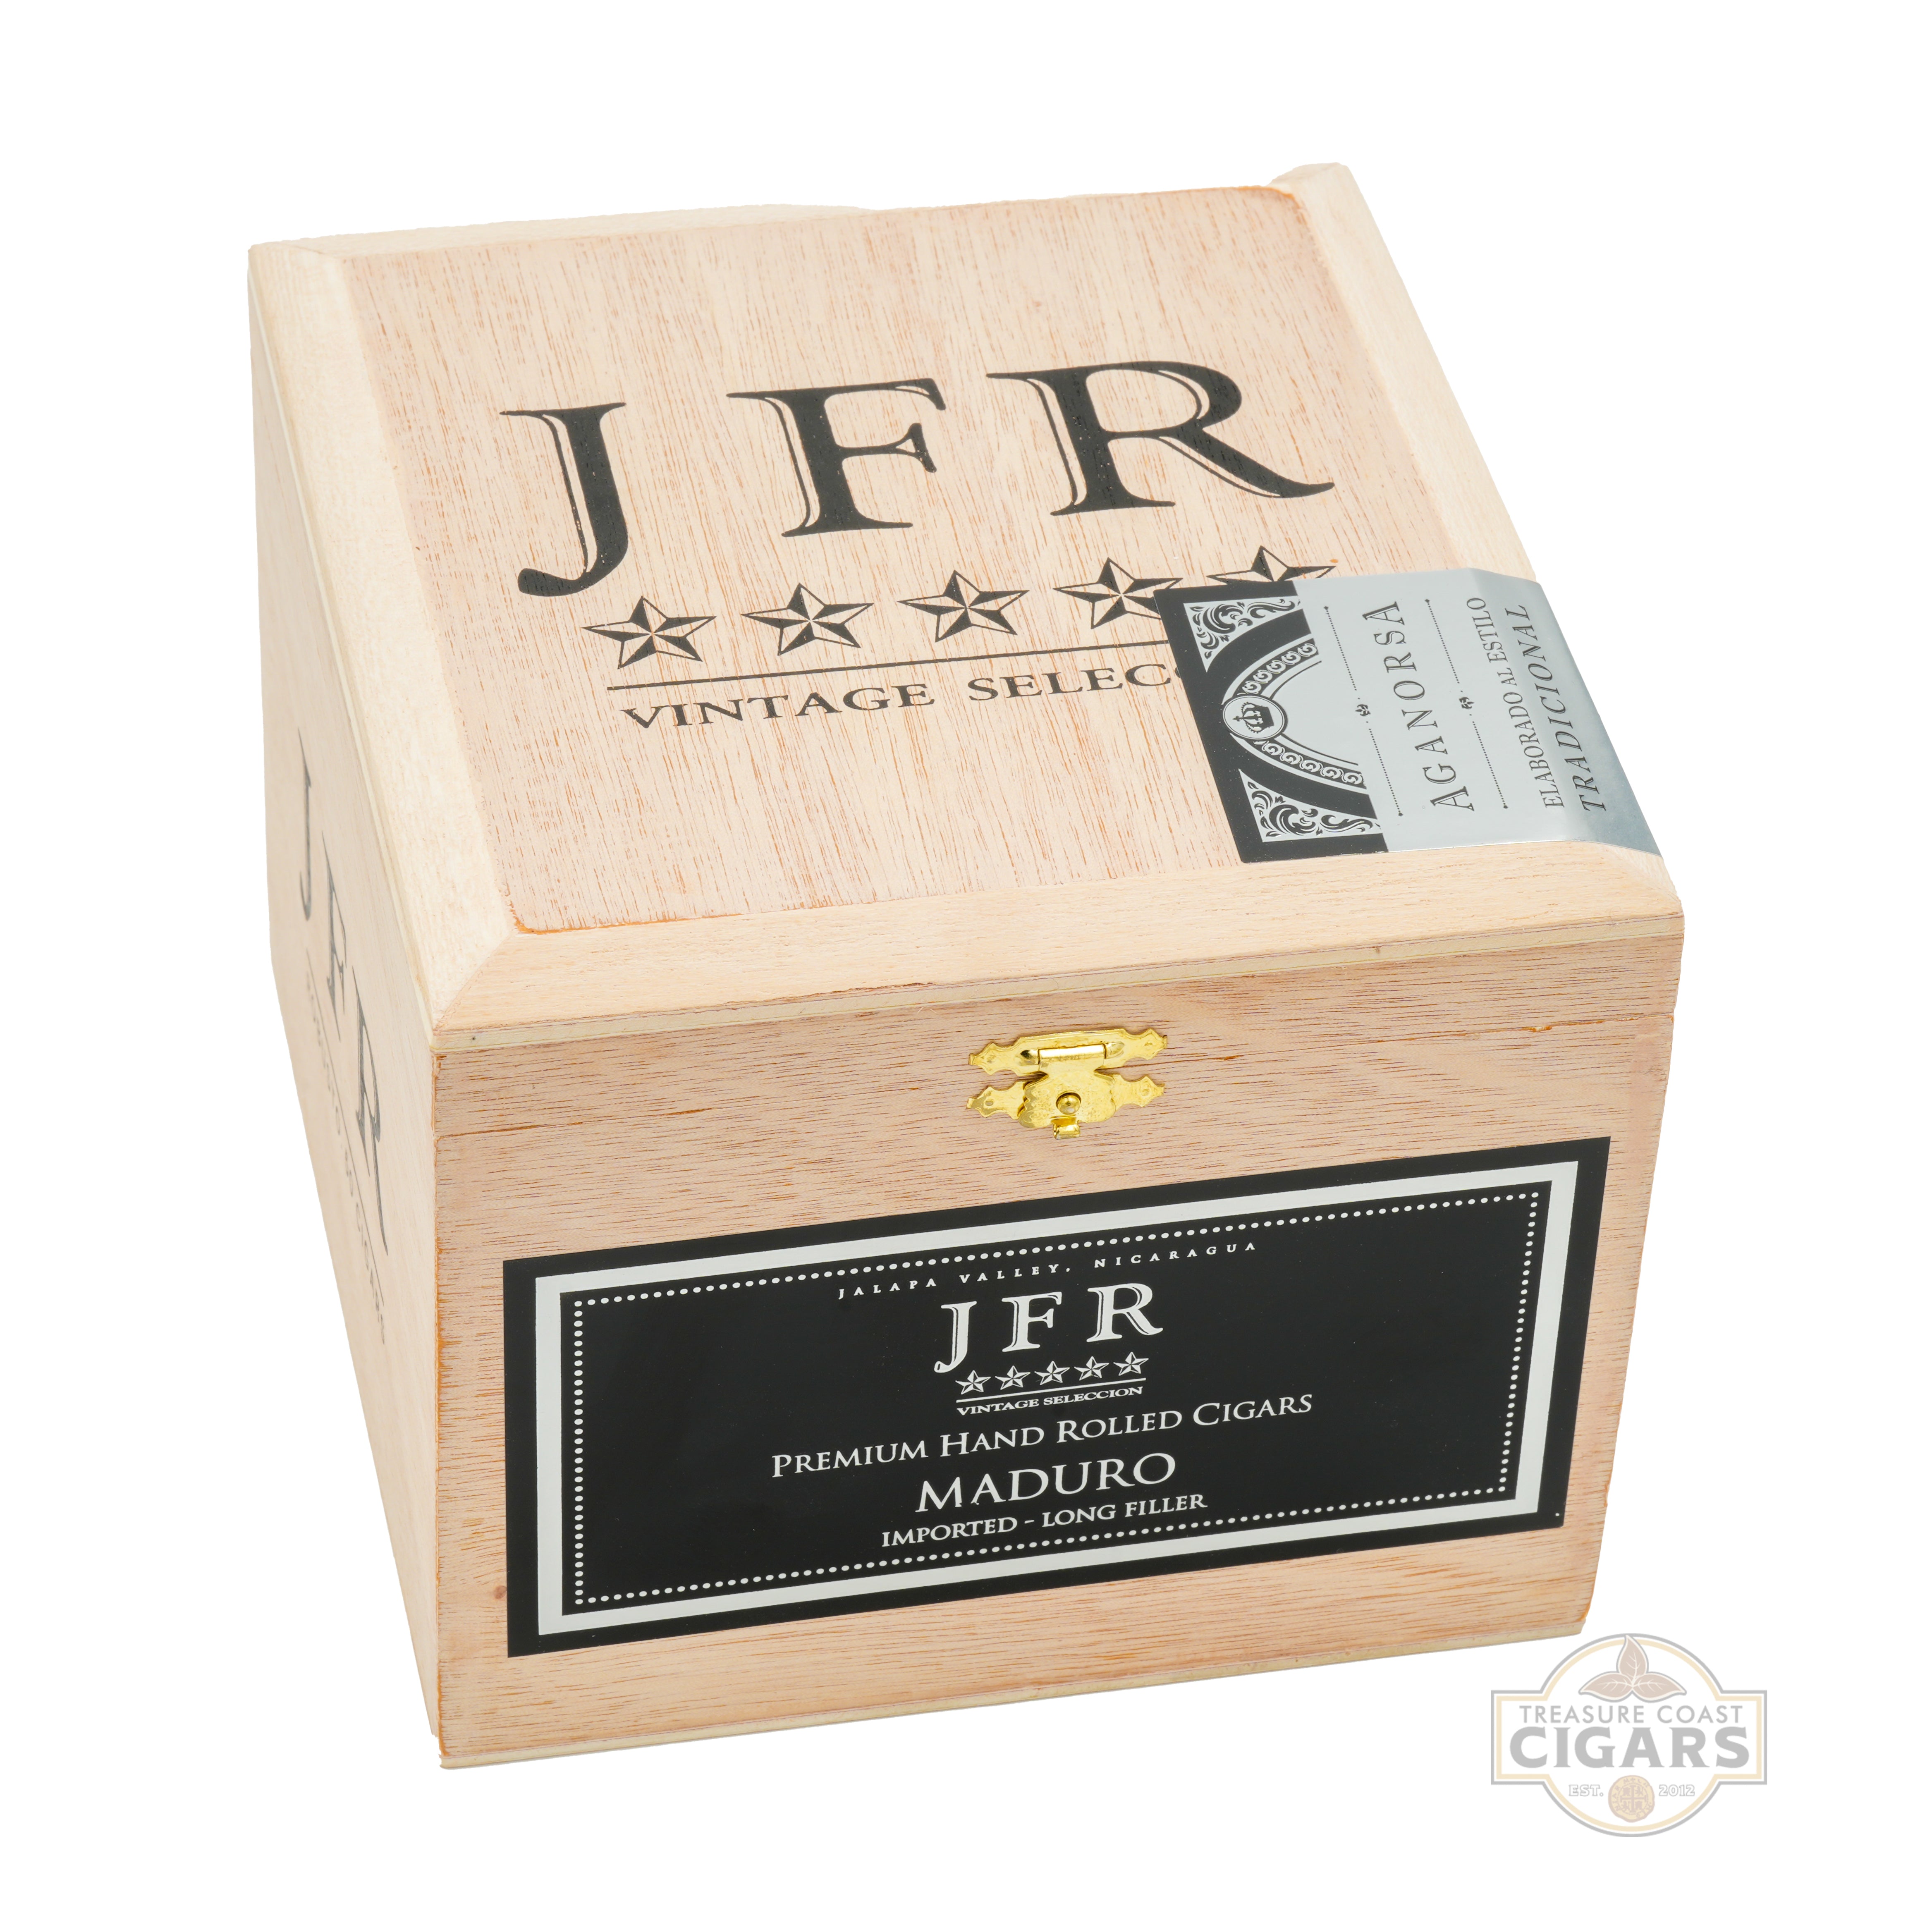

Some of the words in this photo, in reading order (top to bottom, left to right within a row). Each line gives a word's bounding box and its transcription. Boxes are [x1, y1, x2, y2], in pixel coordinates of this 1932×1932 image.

[500, 360, 1335, 597] JFR
[1466, 597, 1508, 663] ESTILO
[621, 683, 935, 728] VINTAGE
[968, 664, 1181, 701] SELEC
[1361, 600, 1475, 812] AGANORSA
[1497, 667, 1518, 687] AL
[1505, 605, 1607, 812] TRADICIONAL
[1503, 691, 1565, 809] ELABORADO
[356, 1202, 385, 1345] CIGARS
[839, 1279, 937, 1300] JALAPA
[1094, 1242, 1256, 1268] NICARAGUA
[934, 1283, 1163, 1374] JFR
[772, 1440, 929, 1478] PREMIUM
[940, 1427, 1045, 1457] HAND
[1057, 1411, 1183, 1444] ROLLED
[1193, 1394, 1313, 1426] CIGARS
[957, 1398, 1040, 1416] VINTAGE
[1043, 1386, 1143, 1406] SELECCION
[882, 1517, 1018, 1547] IMPORTED
[1042, 1504, 1117, 1527] LONG
[1125, 1494, 1208, 1518] FILLER
[915, 1453, 1176, 1513] MADURO
